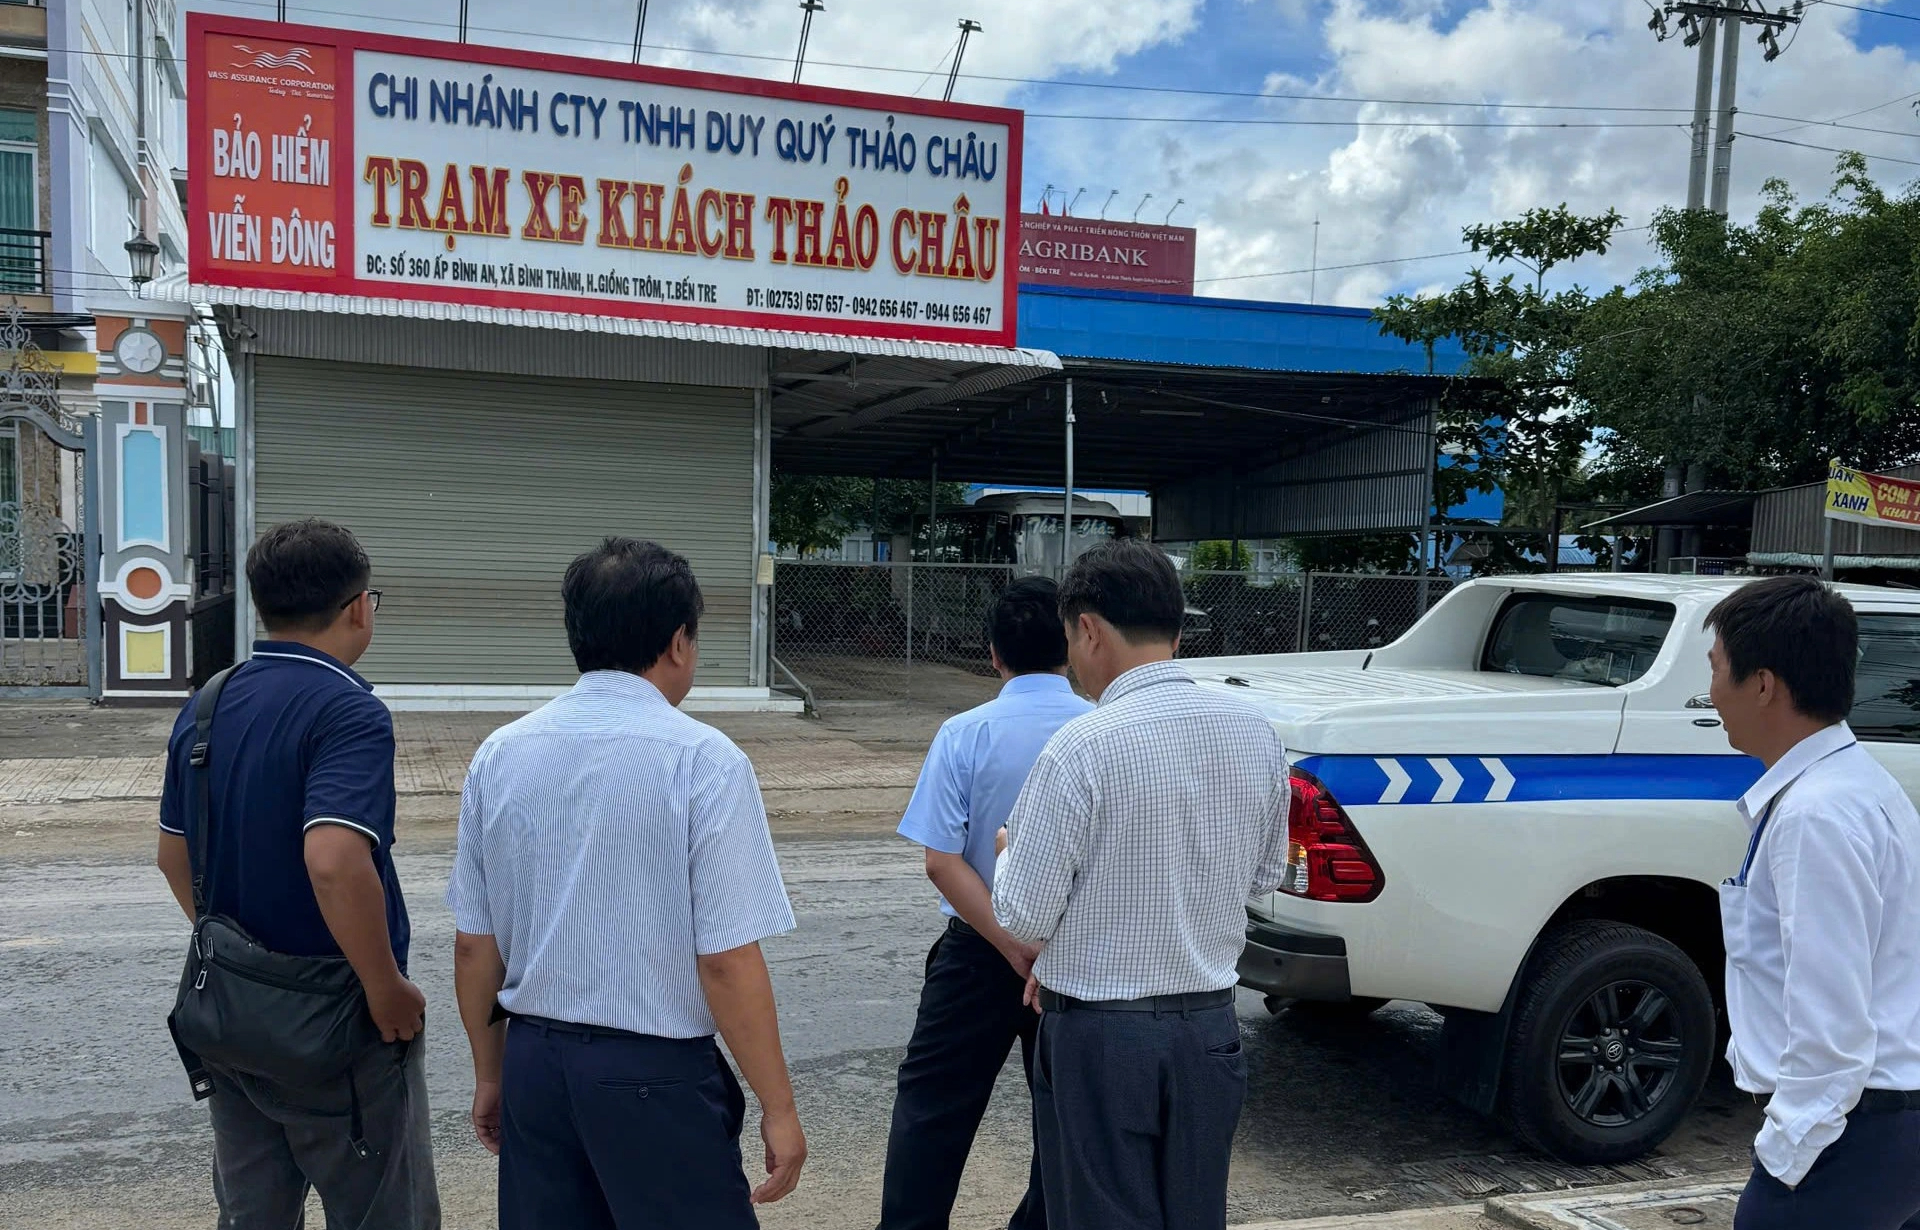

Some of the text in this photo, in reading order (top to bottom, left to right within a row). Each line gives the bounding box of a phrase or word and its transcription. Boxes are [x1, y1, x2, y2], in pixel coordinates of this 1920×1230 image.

[208, 70, 335, 91] VASS ASSURANCE CORPORATION
[368, 72, 998, 182] CHI NHÁNH CTY TNHH DUY QUÝ THẢO CHÂU
[213, 112, 330, 186] BẢO HIỂM
[208, 194, 336, 269] VIỄN ĐÔNG
[364, 155, 1000, 283] TRẠM XE KHÁCH THẢO CHÂU
[1052, 222, 1062, 231] VÀ
[1019, 239, 1149, 267] AGRIBANK
[366, 254, 386, 274] ĐC:
[390, 250, 406, 276] SỐ
[409, 258, 430, 278] 360
[433, 253, 448, 280] ẤP
[452, 257, 477, 283] BÌNH
[480, 264, 498, 288] AN,
[500, 263, 515, 286] XÃ
[518, 263, 543, 288] BÌNH
[546, 266, 584, 296] THÀNH,
[632, 275, 665, 303] TRÔM,
[666, 275, 695, 302] T.BẾN
[697, 283, 717, 303] TRE
[1049, 268, 1061, 276] TRE
[746, 288, 763, 307] ĐT:
[766, 288, 803, 311] (02753)
[806, 293, 824, 312] 657
[825, 294, 844, 313] 657
[852, 296, 878, 316] 0942
[879, 299, 898, 317] 656
[899, 300, 918, 319] 467
[925, 302, 950, 322] 0944
[952, 305, 970, 323] 656
[972, 306, 992, 325] 467
[1832, 491, 1870, 512] XANH
[1881, 506, 1911, 520] KHAI
